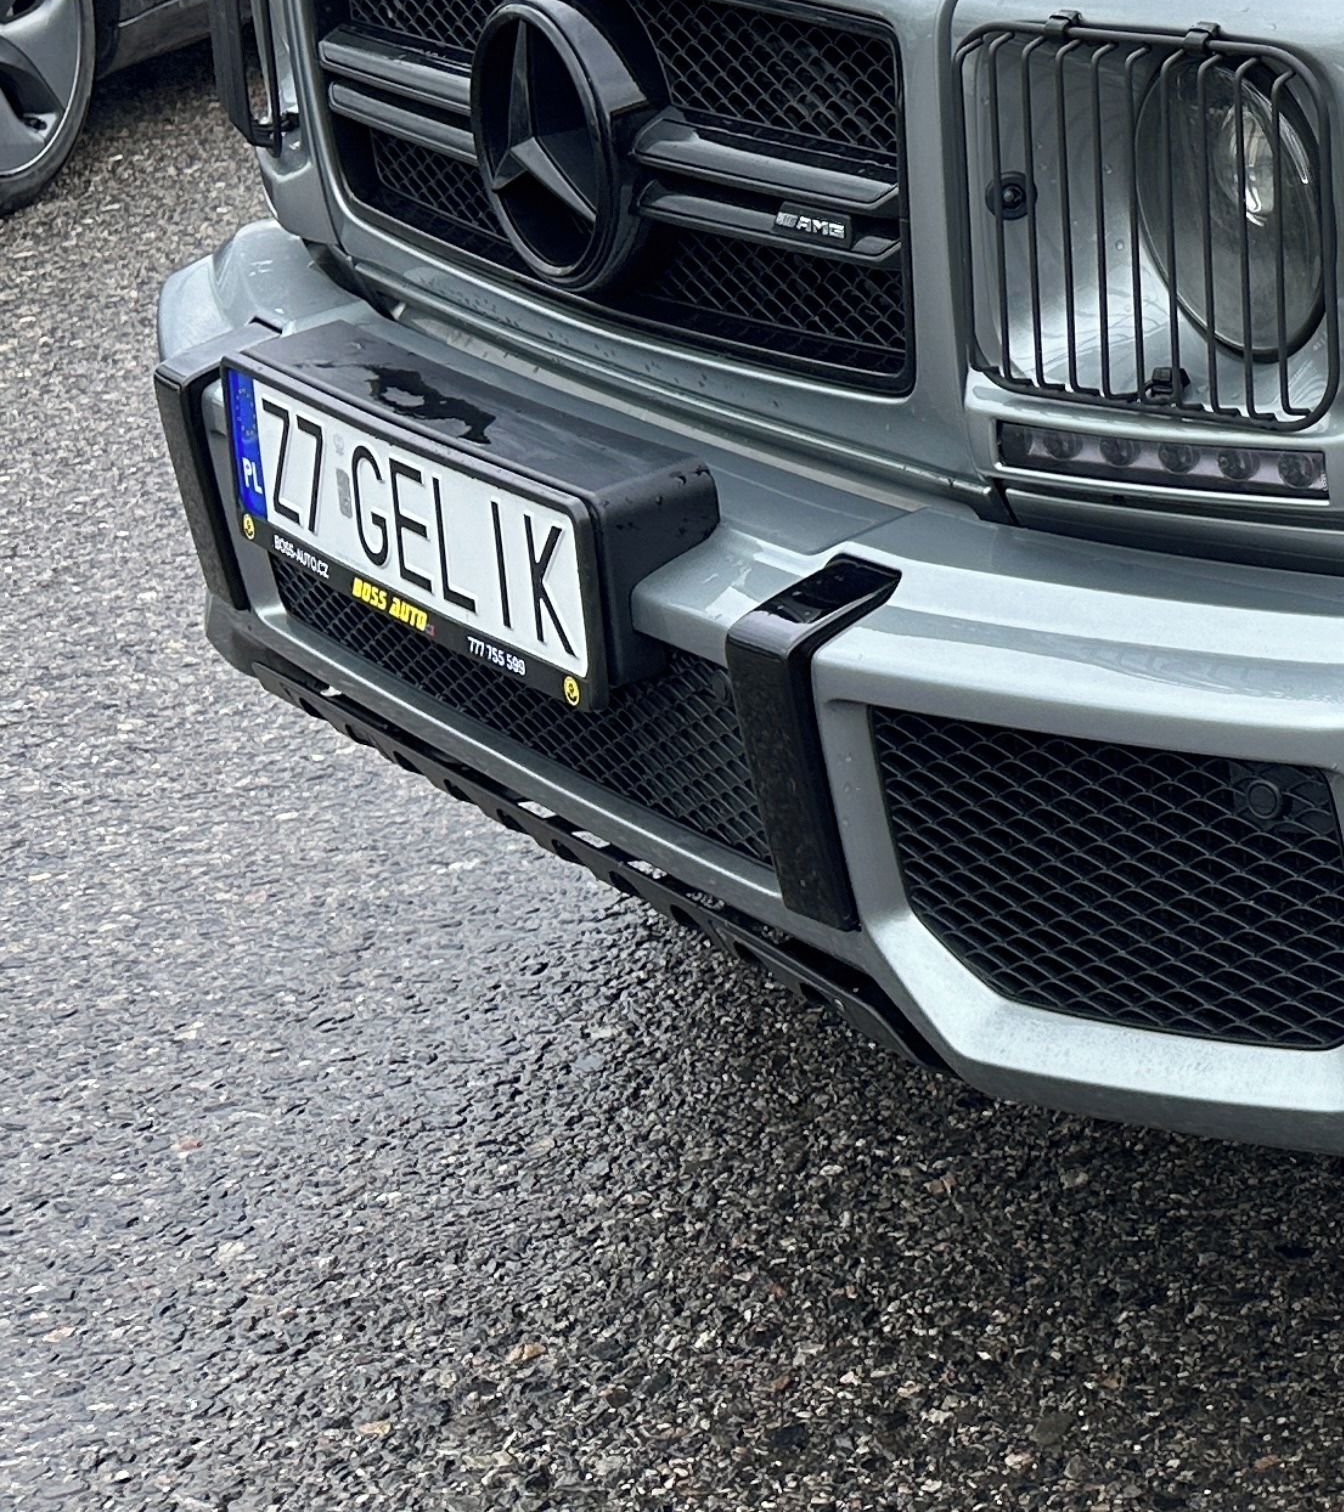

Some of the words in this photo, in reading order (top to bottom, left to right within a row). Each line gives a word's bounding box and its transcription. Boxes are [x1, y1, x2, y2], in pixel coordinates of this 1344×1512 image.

[796, 216, 845, 239] AMG
[242, 457, 263, 494] PL
[351, 445, 577, 658] GELIK
[352, 577, 387, 611] BOSS
[467, 635, 485, 657] 777
[486, 645, 506, 667] 755
[506, 654, 526, 677] 599
